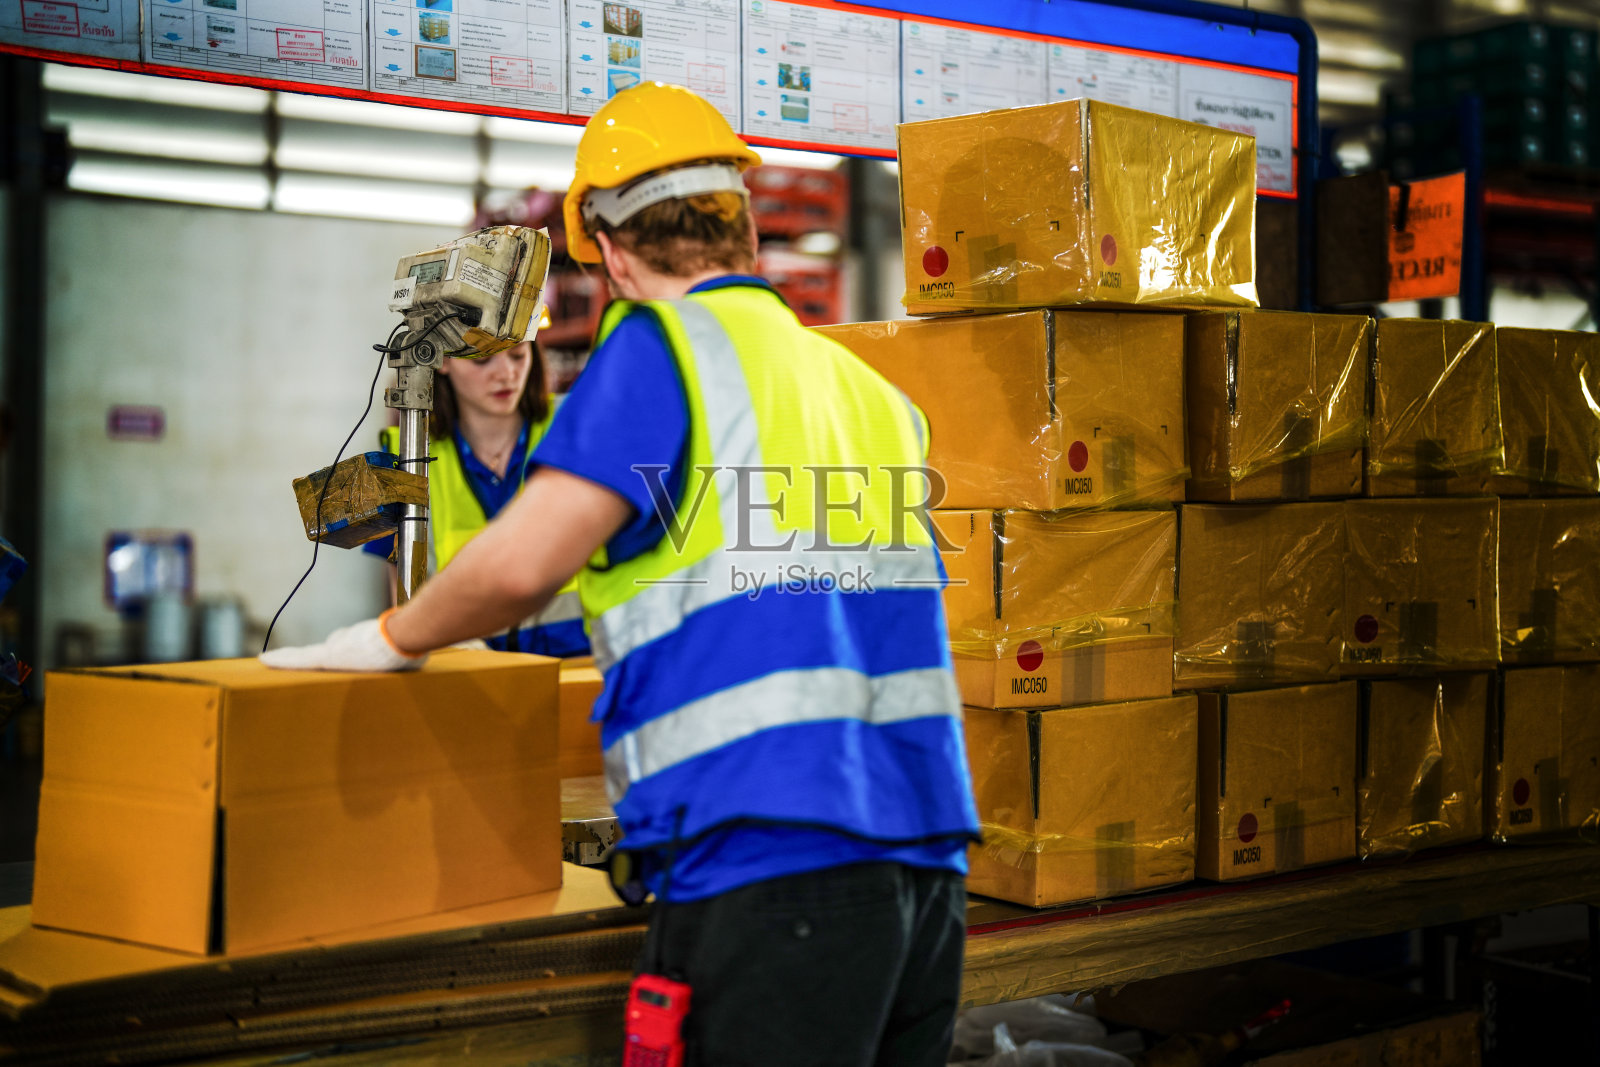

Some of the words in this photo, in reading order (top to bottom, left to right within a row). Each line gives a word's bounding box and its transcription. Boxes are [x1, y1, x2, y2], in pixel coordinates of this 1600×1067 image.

[394, 288, 410, 300] WS01
[919, 281, 955, 299] IMC050
[1065, 477, 1092, 495] IMC050
[1011, 676, 1047, 695] IMC050
[1233, 846, 1261, 866] IMC050
